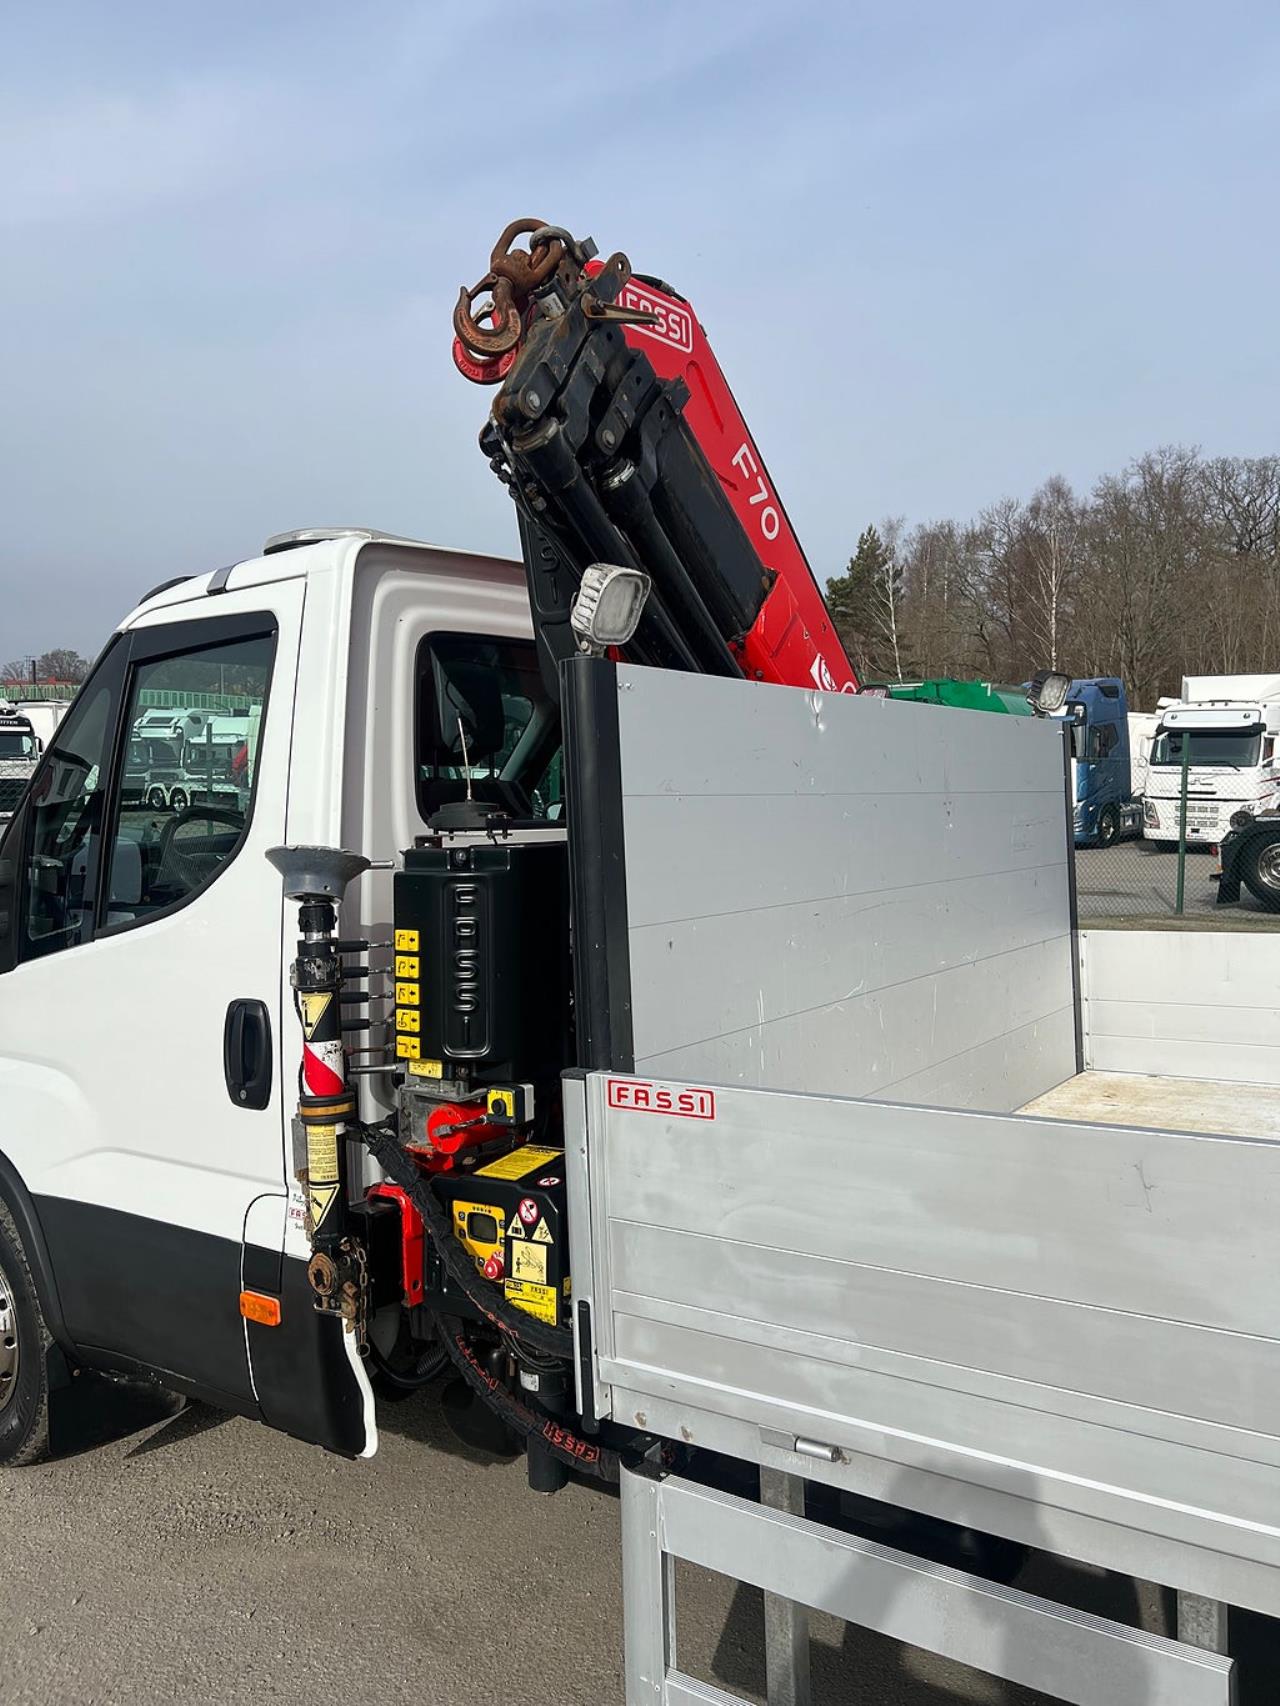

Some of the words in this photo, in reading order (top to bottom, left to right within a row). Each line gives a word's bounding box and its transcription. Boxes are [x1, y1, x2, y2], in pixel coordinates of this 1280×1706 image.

[732, 443, 779, 540] F70
[456, 884, 478, 1046] FASSI
[616, 1087, 705, 1113] FASSI
